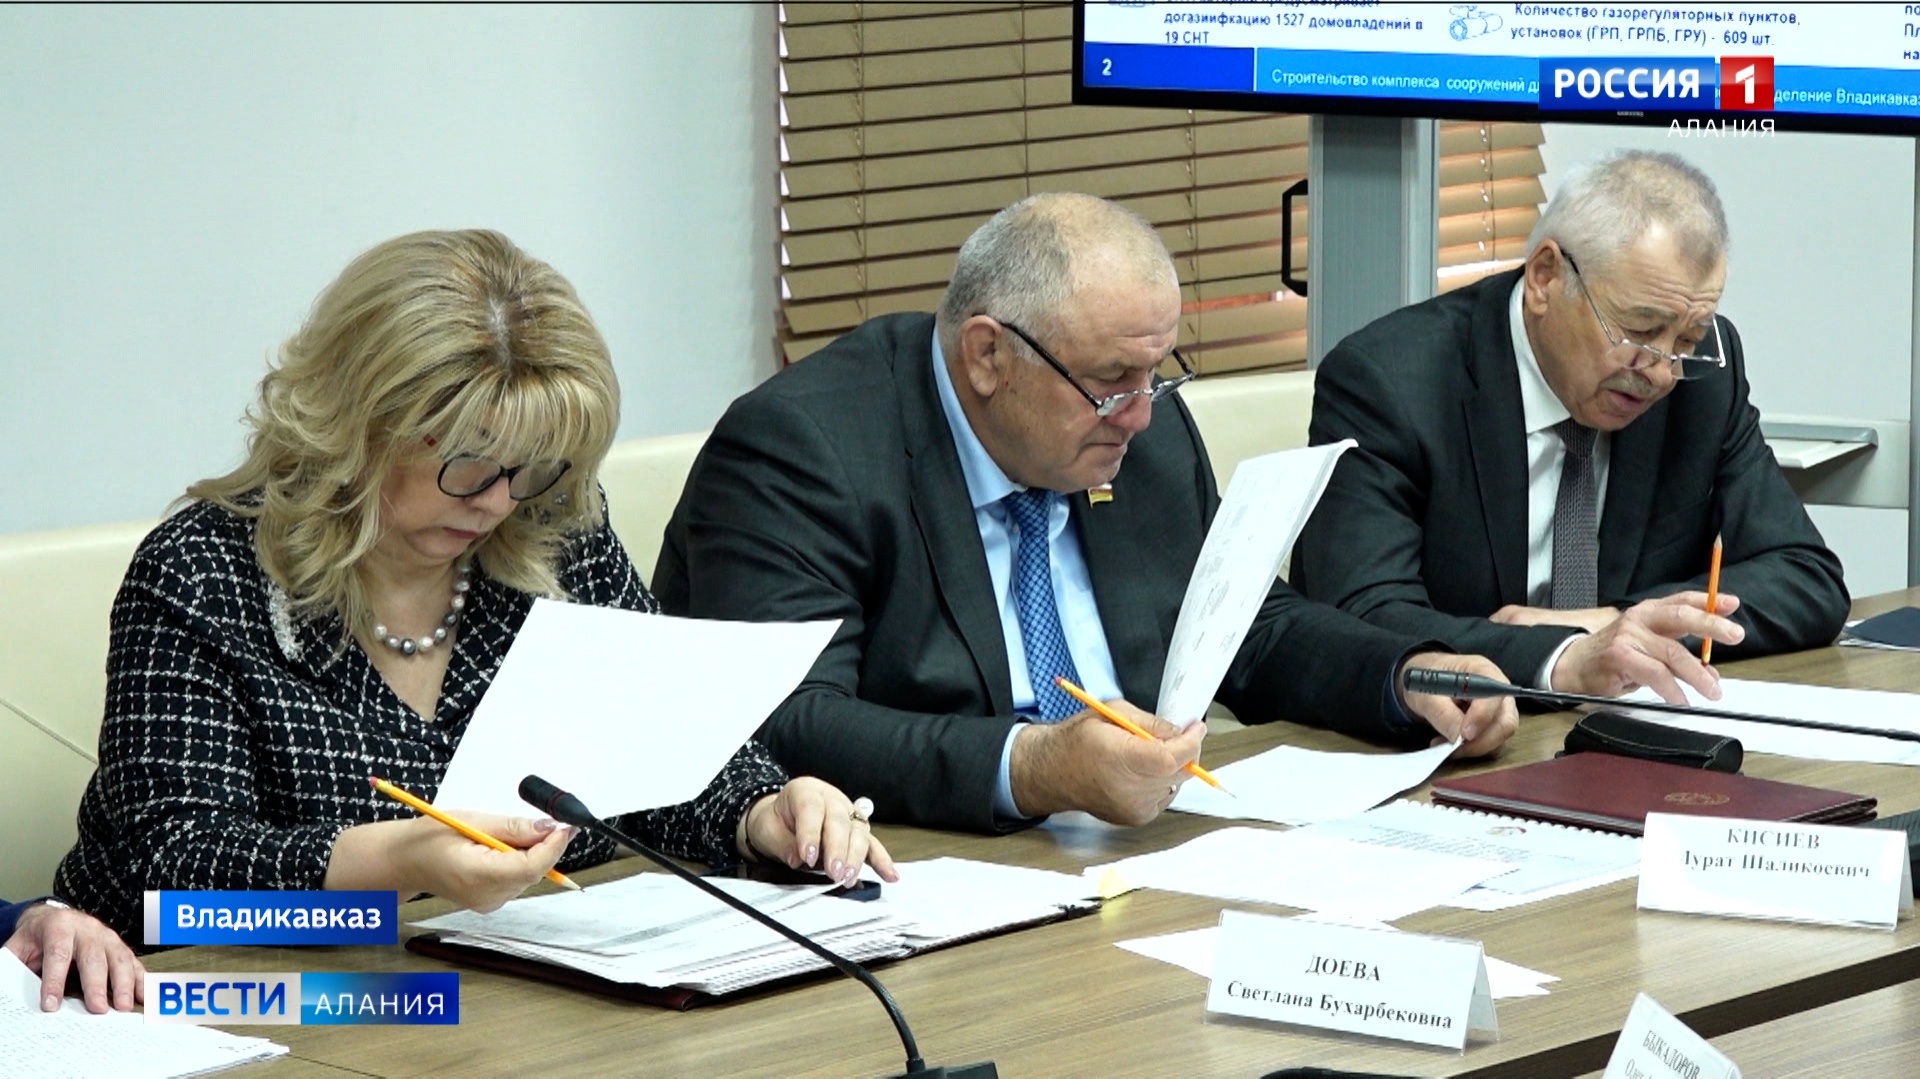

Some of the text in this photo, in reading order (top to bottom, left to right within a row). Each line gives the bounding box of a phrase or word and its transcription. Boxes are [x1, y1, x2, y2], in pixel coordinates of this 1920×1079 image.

[1277, 13, 1305, 26] 1527
[1308, 16, 1411, 31] домовладений
[1515, 3, 1800, 26] Количество газорегуляторных пунктов,
[1165, 31, 1210, 44] 19 СНТ
[1510, 27, 1583, 40] установок
[1586, 26, 1624, 43] (ГРП,
[1628, 27, 1670, 43] ГРПБ,
[1674, 28, 1708, 47] ГРУ)
[1723, 31, 1748, 44] 609
[1752, 34, 1775, 46] шт.
[1101, 59, 1113, 76] 2
[1271, 69, 1368, 87] Строительство
[1371, 75, 1440, 88] комплекса
[1446, 77, 1525, 94] сооружений
[1836, 87, 1920, 106] Владикавка
[1727, 828, 1820, 849] КИСИЕВ
[1305, 955, 1381, 983] ДОЕВА
[1227, 980, 1453, 1030] Светлана Бухарбековна
